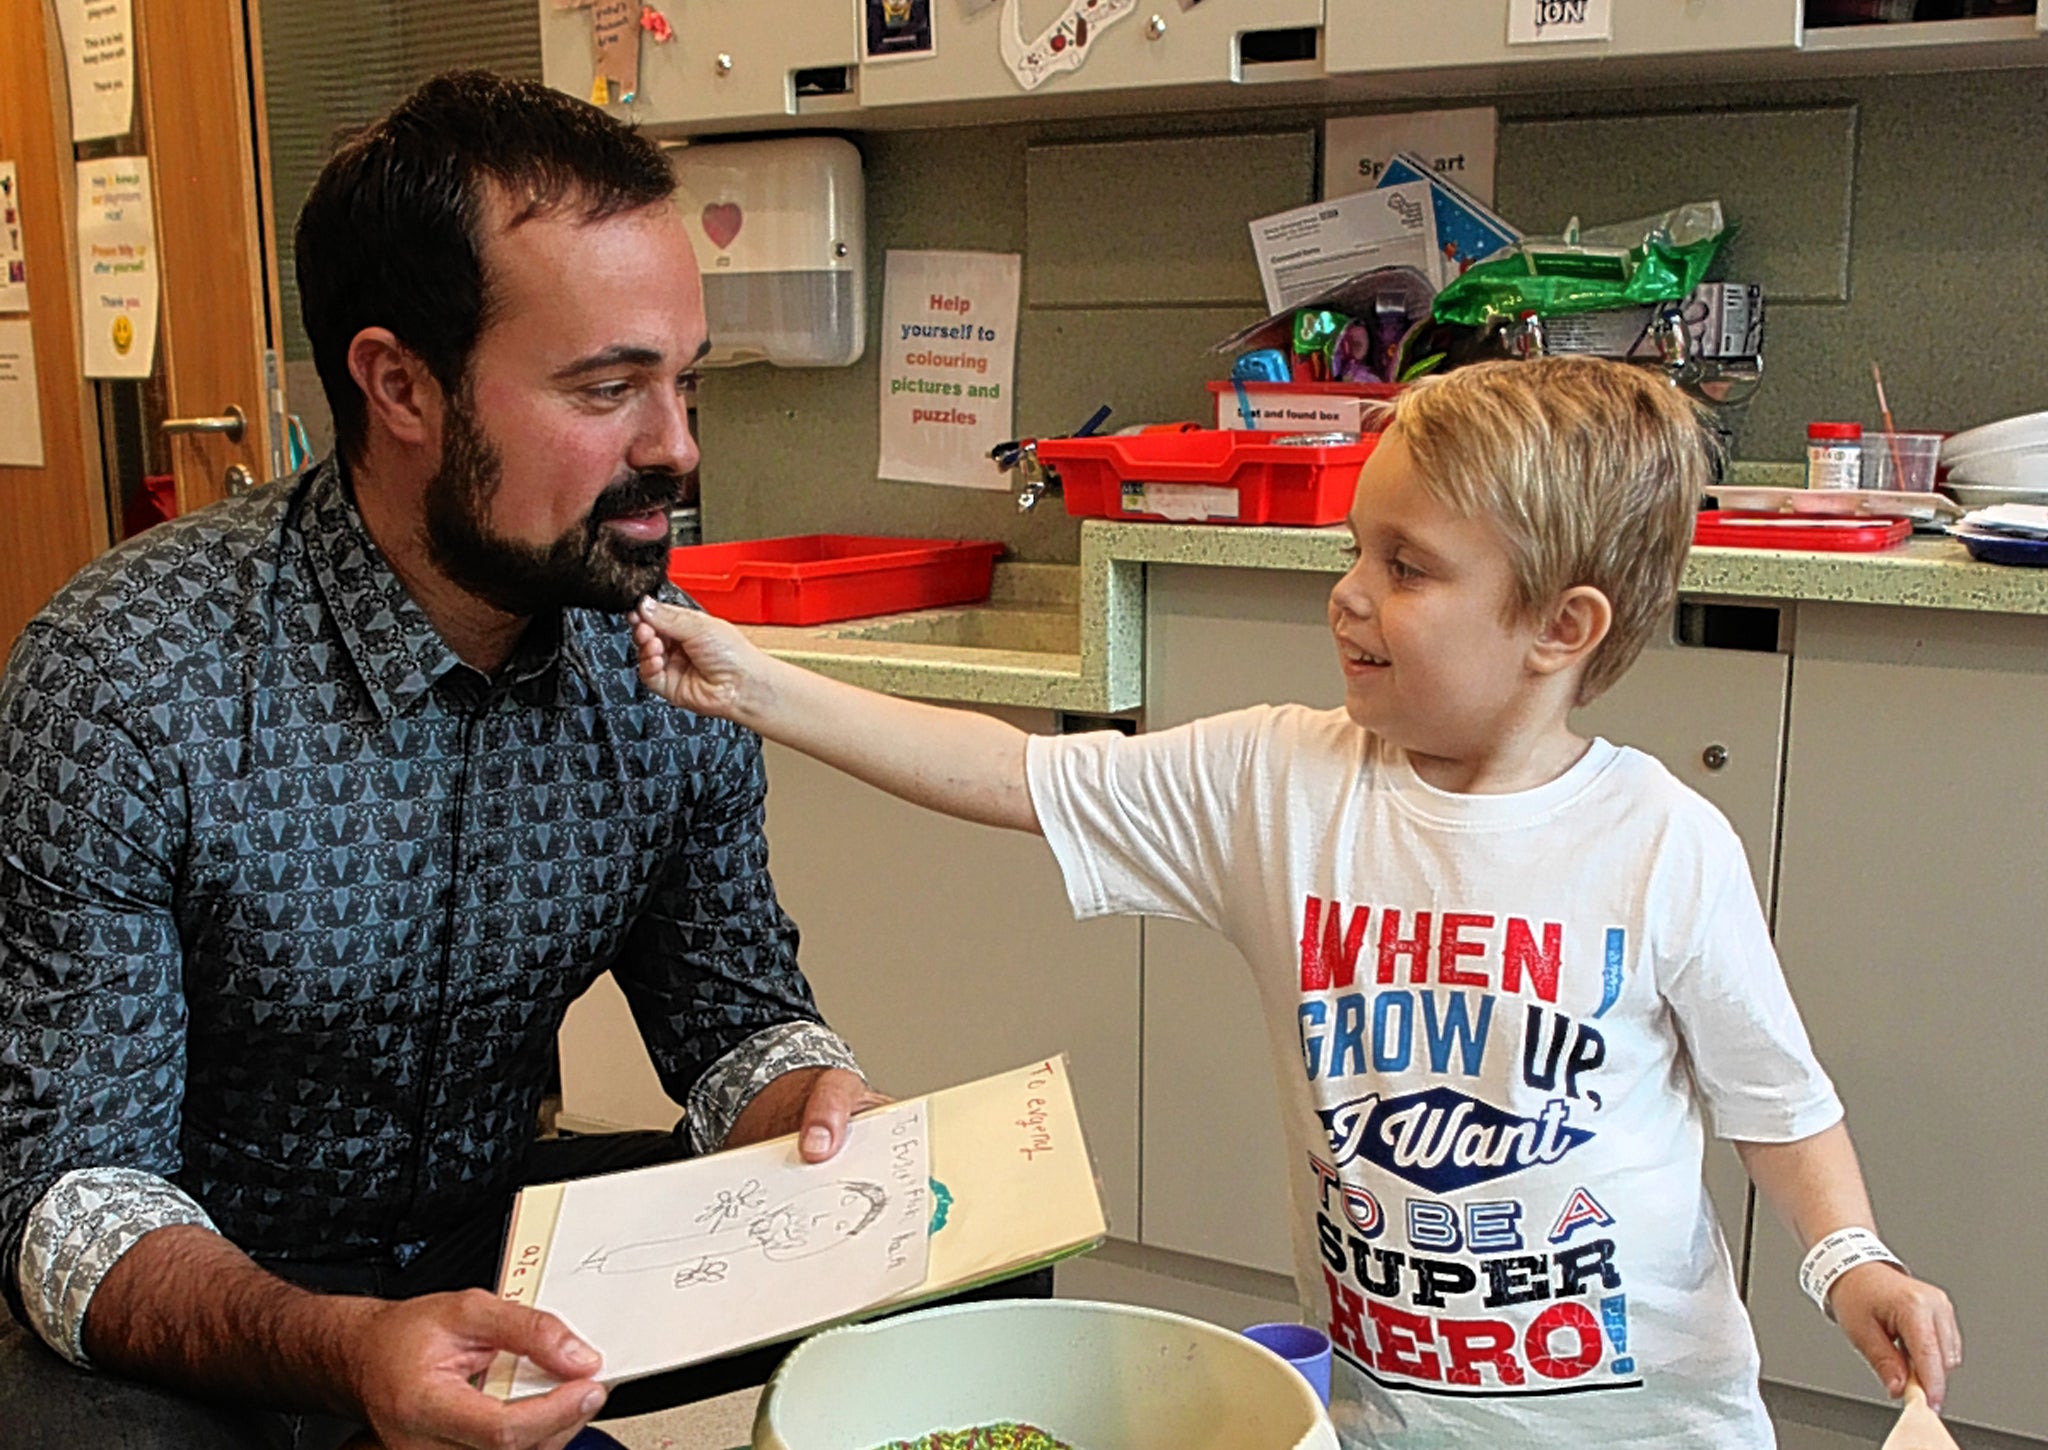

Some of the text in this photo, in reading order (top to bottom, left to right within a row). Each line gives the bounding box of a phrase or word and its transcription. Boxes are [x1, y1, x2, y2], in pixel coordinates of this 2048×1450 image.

[1433, 153, 1465, 173] art
[930, 294, 971, 315] Help
[901, 323, 996, 341] yourself to
[906, 350, 988, 374] colouring
[891, 377, 1000, 399] pictures and
[912, 408, 977, 425] puzzles
[1264, 409, 1284, 419] and
[1286, 408, 1317, 420] found
[1320, 410, 1340, 421] box
[1300, 895, 1562, 1004] WHEN
[1298, 989, 1606, 1112] GROW UP,
[1027, 1061, 1053, 1090] To
[1327, 1093, 1572, 1169] I Want
[1307, 1150, 1616, 1254] TO BE A
[1317, 1211, 1622, 1309] SUPER
[1320, 1263, 1636, 1386] HERO!
